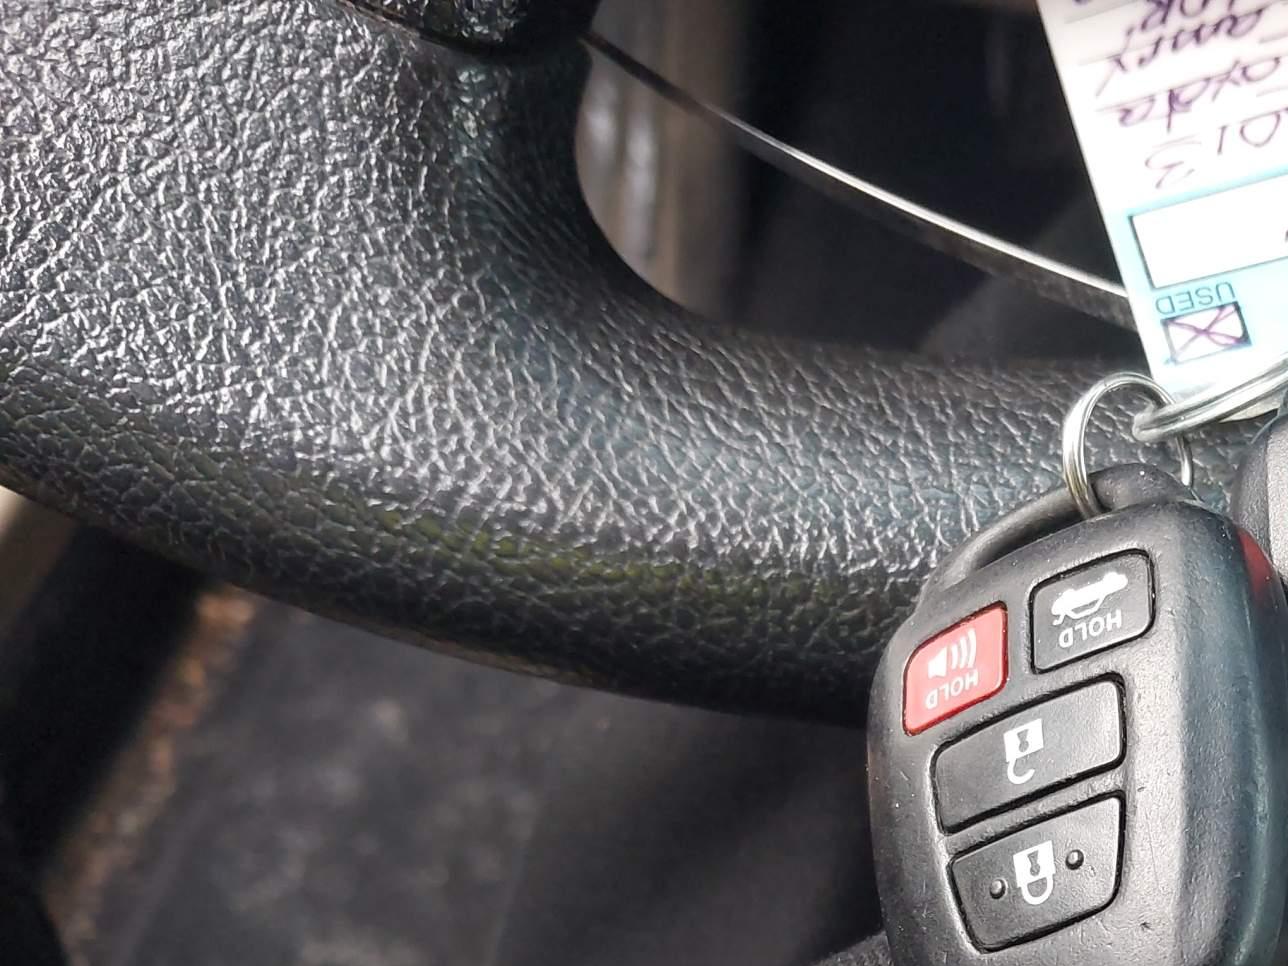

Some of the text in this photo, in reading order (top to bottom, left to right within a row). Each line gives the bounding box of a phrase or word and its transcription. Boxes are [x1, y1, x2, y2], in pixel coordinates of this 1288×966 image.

[1155, 281, 1237, 316] USED
[1058, 609, 1122, 649] HOLD
[924, 669, 979, 710] HOLD
